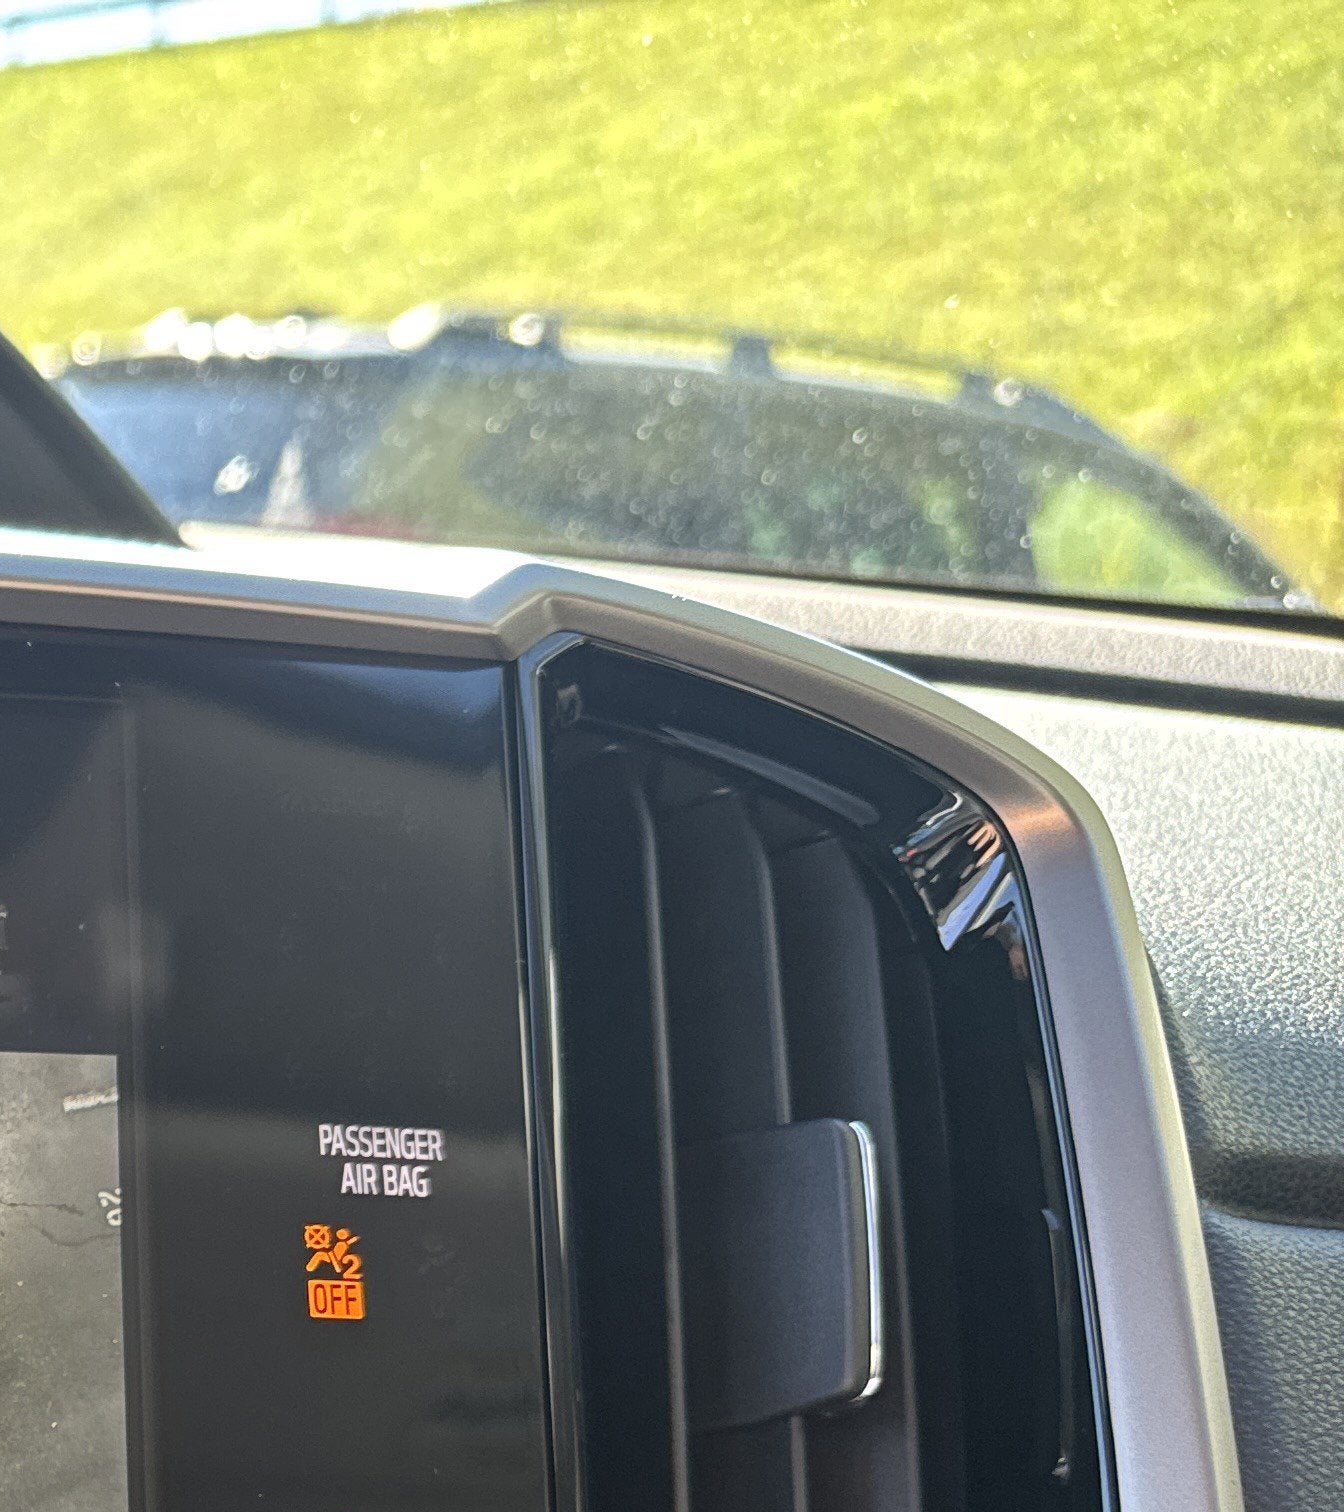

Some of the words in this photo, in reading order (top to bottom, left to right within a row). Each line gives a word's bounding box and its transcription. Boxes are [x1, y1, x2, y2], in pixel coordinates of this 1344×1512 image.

[318, 1124, 443, 1161] PASSENGER
[341, 1162, 379, 1195] AIR
[382, 1165, 431, 1198] BAG
[313, 1283, 358, 1315] OFF
